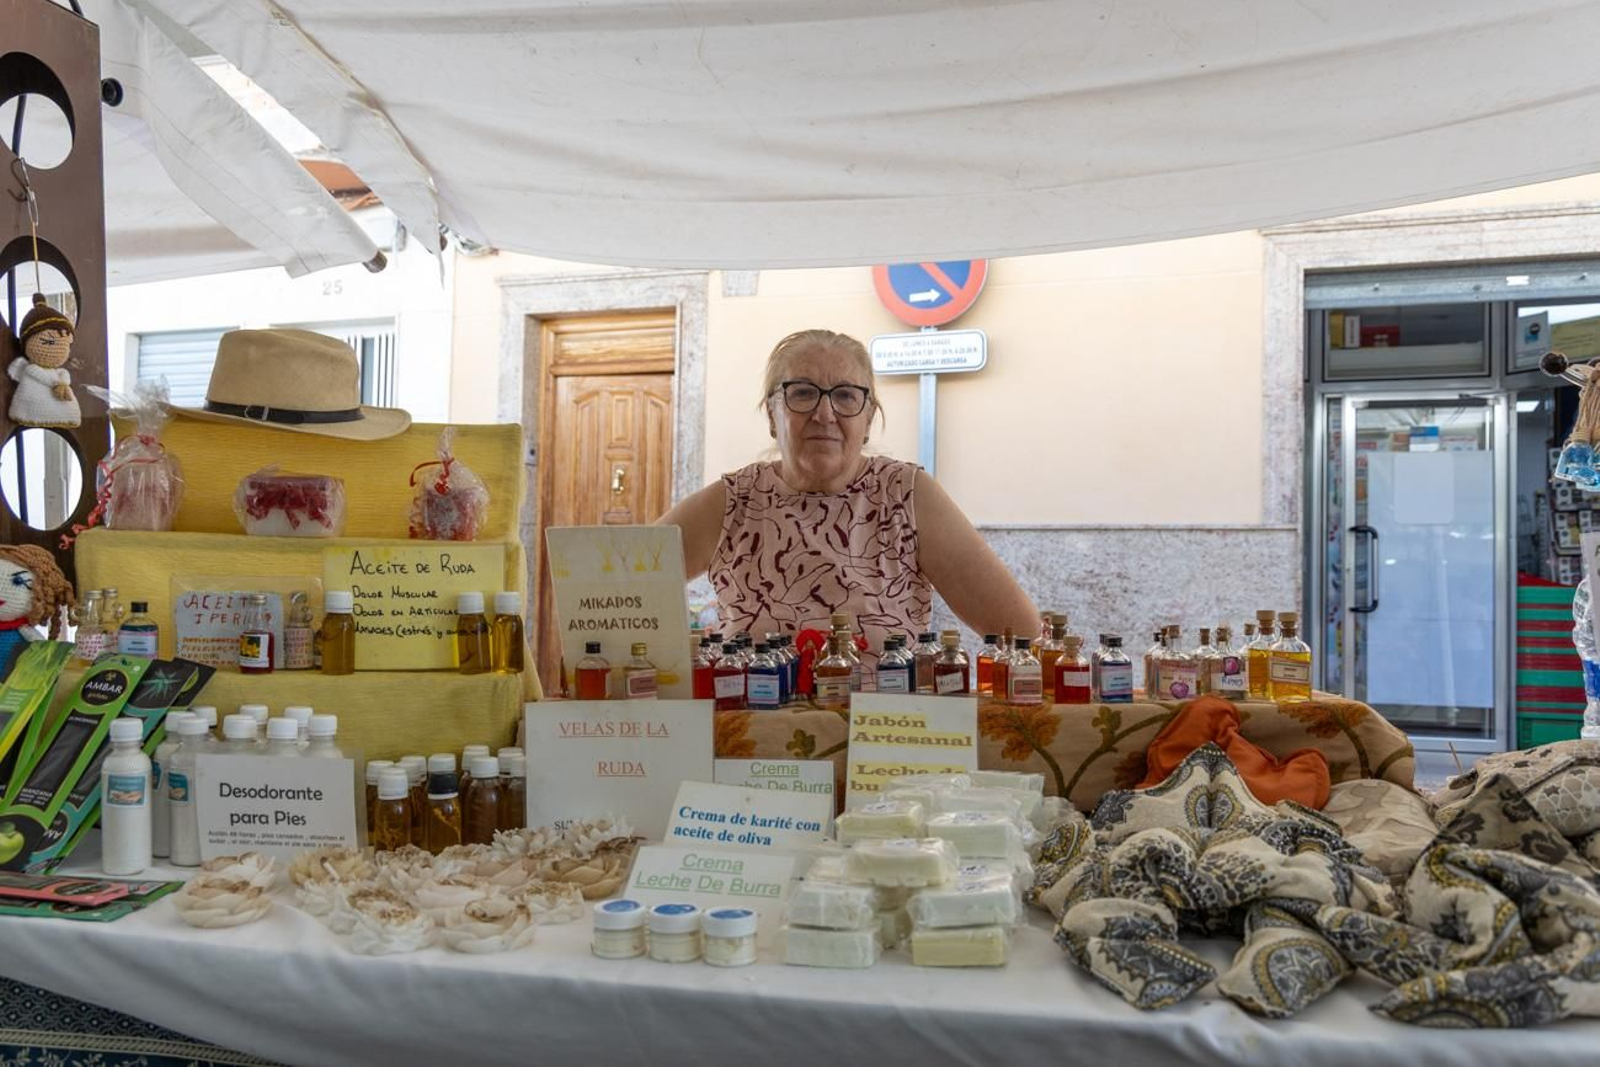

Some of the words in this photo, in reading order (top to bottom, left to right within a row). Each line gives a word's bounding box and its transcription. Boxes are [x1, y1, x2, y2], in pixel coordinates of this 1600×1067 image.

[322, 279, 343, 296] 25
[416, 563, 430, 574] DE
[440, 553, 476, 575] RUDA
[579, 596, 643, 610] MIKADOS
[568, 617, 660, 631] AROMATICOS
[85, 681, 123, 695] AMBAR
[559, 722, 615, 737] VELAS
[619, 722, 642, 737] DE
[647, 722, 669, 737] LA
[854, 715, 926, 729] Jabón
[853, 732, 973, 747] Artesanal
[597, 761, 646, 776] RUDA
[750, 761, 799, 776] Crema
[219, 782, 323, 801] Desodorante
[230, 813, 269, 827] para
[274, 811, 307, 826] Pies
[679, 806, 727, 823] Crema
[730, 812, 747, 826] de
[750, 815, 792, 830] karité
[796, 821, 821, 832] con
[673, 824, 714, 840] aceite
[717, 829, 735, 842] de
[738, 832, 772, 846] oliva
[681, 853, 744, 873] Crema
[634, 870, 692, 890] Leche
[696, 875, 724, 893] De
[728, 878, 781, 897] Burra
